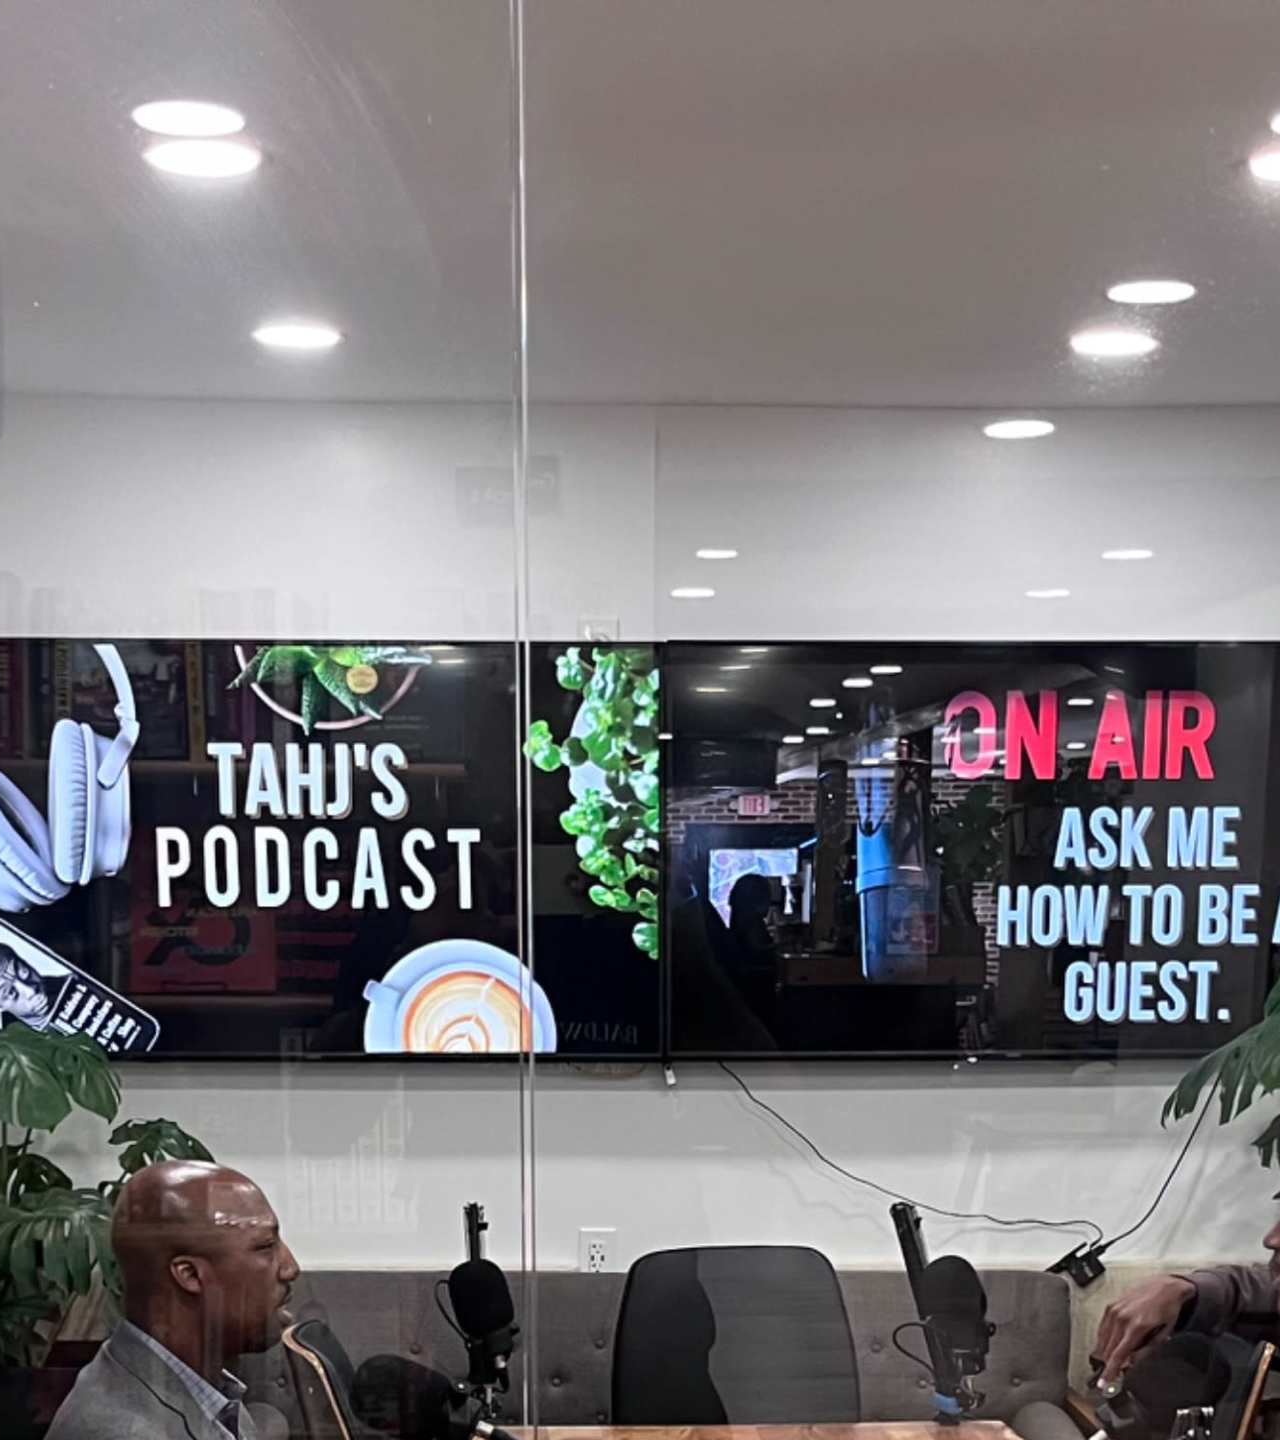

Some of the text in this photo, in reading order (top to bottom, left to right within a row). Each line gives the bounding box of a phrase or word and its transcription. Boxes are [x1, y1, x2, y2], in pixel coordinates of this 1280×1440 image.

[943, 689, 1216, 780] ON AIR
[207, 742, 407, 817] TAHJ'S
[155, 827, 481, 911] PODCAST
[1053, 806, 1240, 868] ASK ME
[996, 885, 1109, 946] HOW
[1123, 885, 1184, 945] TO
[1199, 884, 1259, 944] BE
[1063, 962, 1230, 1023] GUEST.
